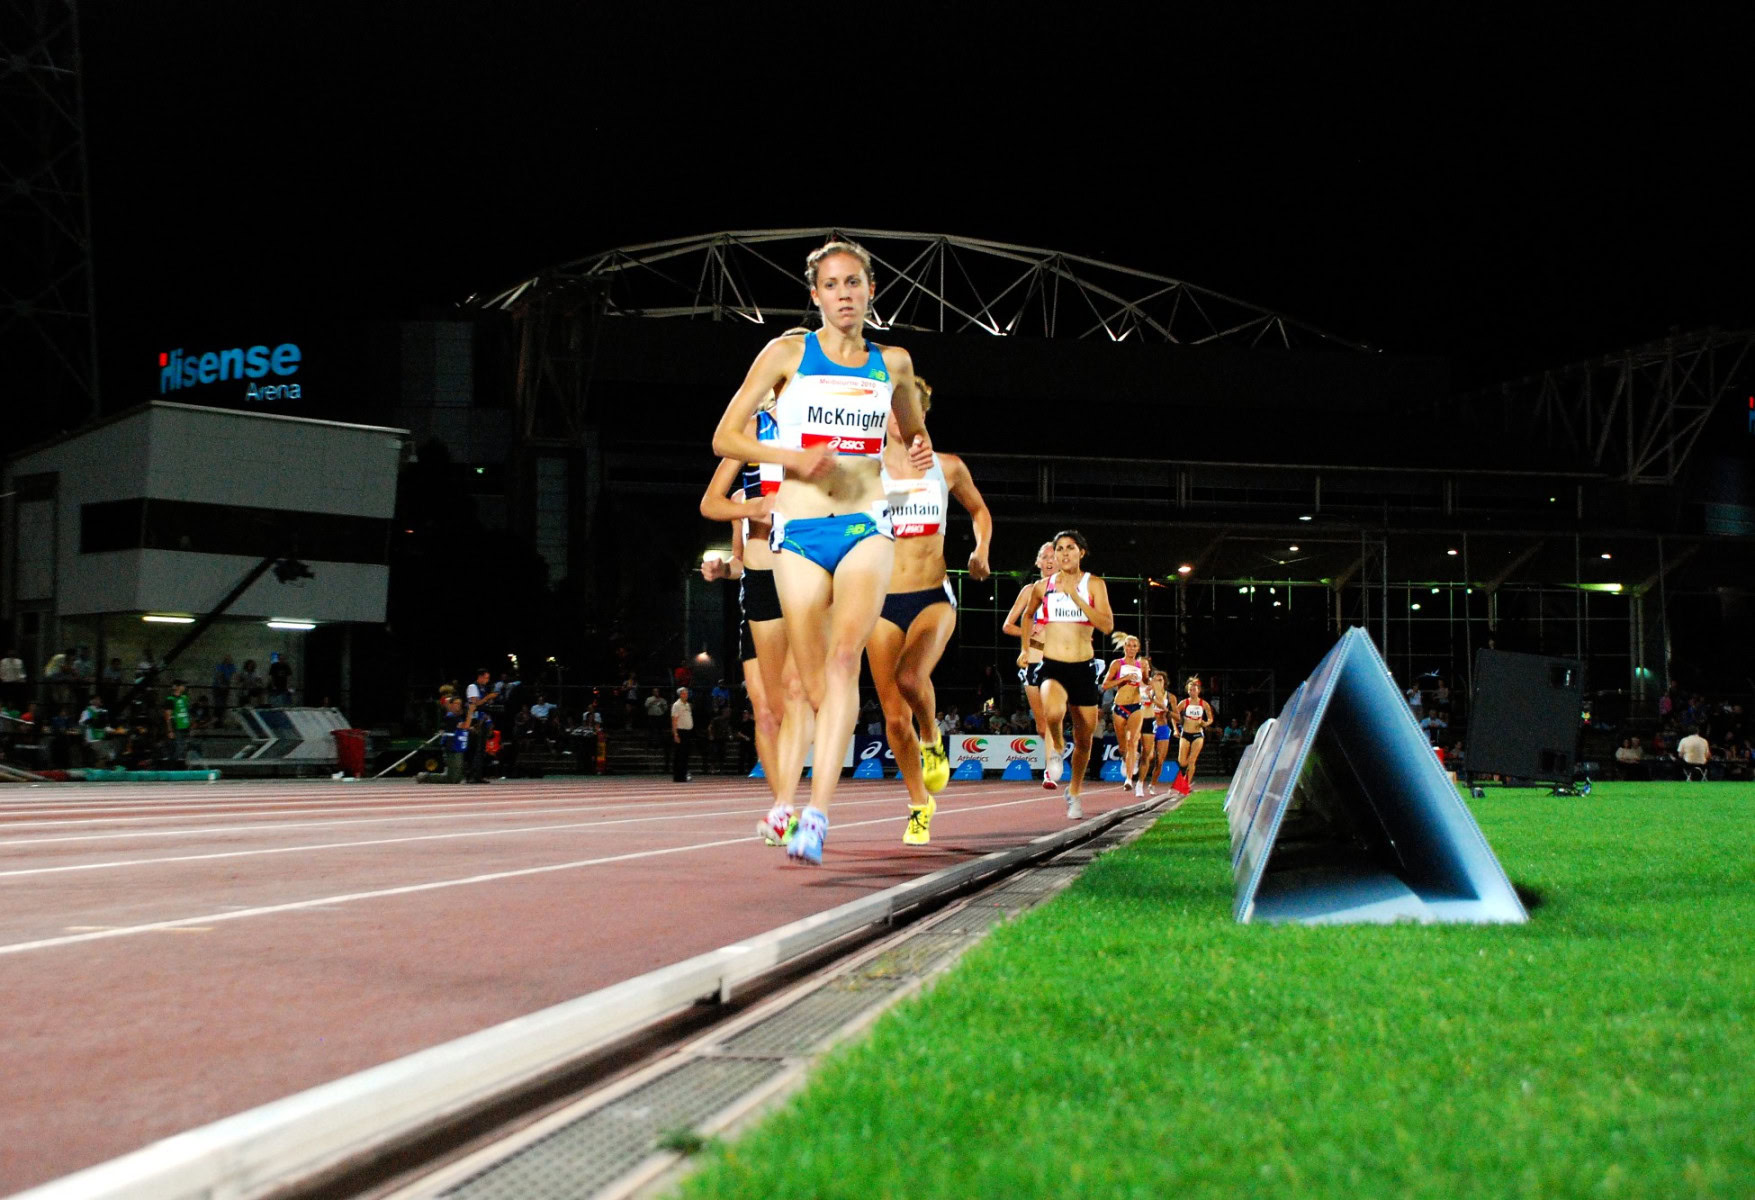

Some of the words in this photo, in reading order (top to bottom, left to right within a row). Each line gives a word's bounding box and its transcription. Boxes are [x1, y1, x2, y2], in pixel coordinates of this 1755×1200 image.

[158, 343, 303, 394] Hisense
[246, 382, 302, 401] Arena
[860, 380, 877, 389] 2010
[807, 405, 886, 431] McKnight
